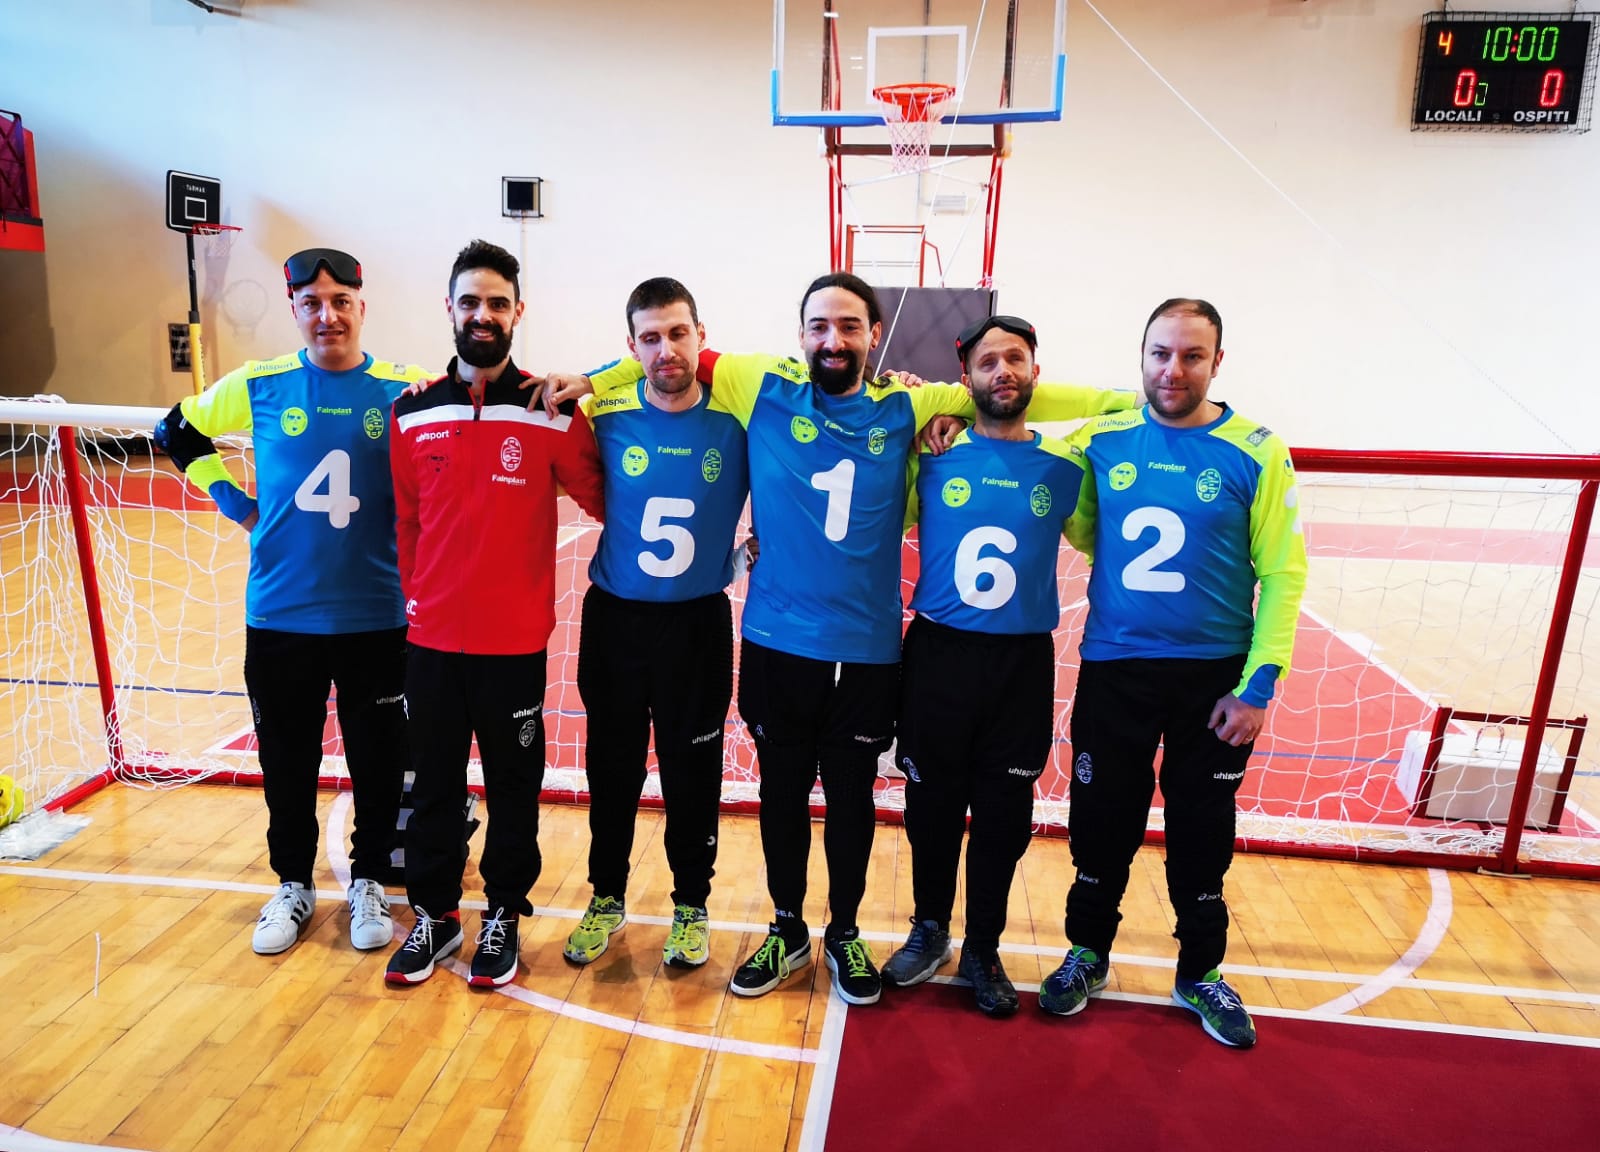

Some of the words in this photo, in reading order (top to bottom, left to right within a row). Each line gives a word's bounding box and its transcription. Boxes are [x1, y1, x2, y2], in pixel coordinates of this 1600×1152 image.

[1438, 31, 1453, 56] 4
[1482, 26, 1560, 62] 10:00
[1454, 71, 1476, 106] 0
[1540, 71, 1563, 106] 0
[1425, 109, 1482, 122] LOCALI
[1513, 110, 1570, 122] OSPITI
[416, 429, 450, 443] uhlsport
[657, 446, 692, 455] Fainplast
[295, 449, 361, 529] 4
[491, 473, 527, 486] Fainplast
[811, 458, 855, 542] 1
[637, 496, 696, 578] 5
[1121, 506, 1186, 593] 2
[954, 526, 1018, 610] 6
